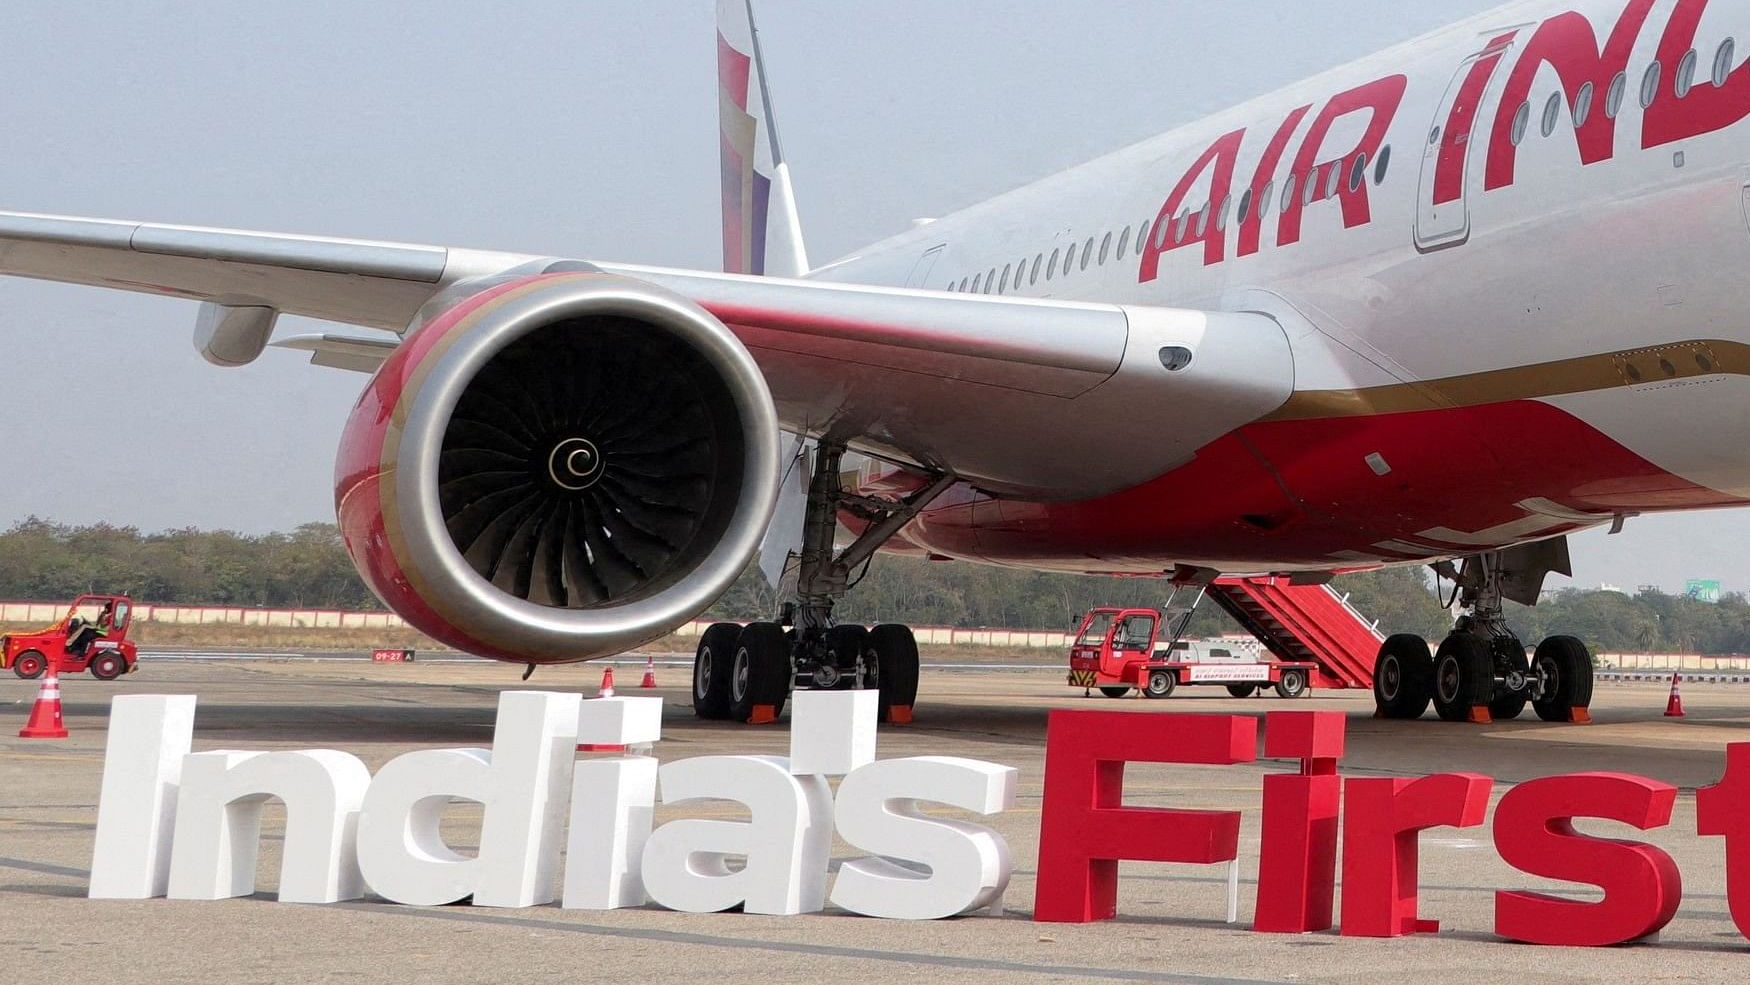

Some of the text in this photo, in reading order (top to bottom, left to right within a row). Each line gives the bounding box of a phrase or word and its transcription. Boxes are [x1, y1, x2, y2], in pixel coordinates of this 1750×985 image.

[1138, 71, 1407, 285] AIR
[375, 652, 402, 661] 09-27
[88, 689, 1016, 920] India's
